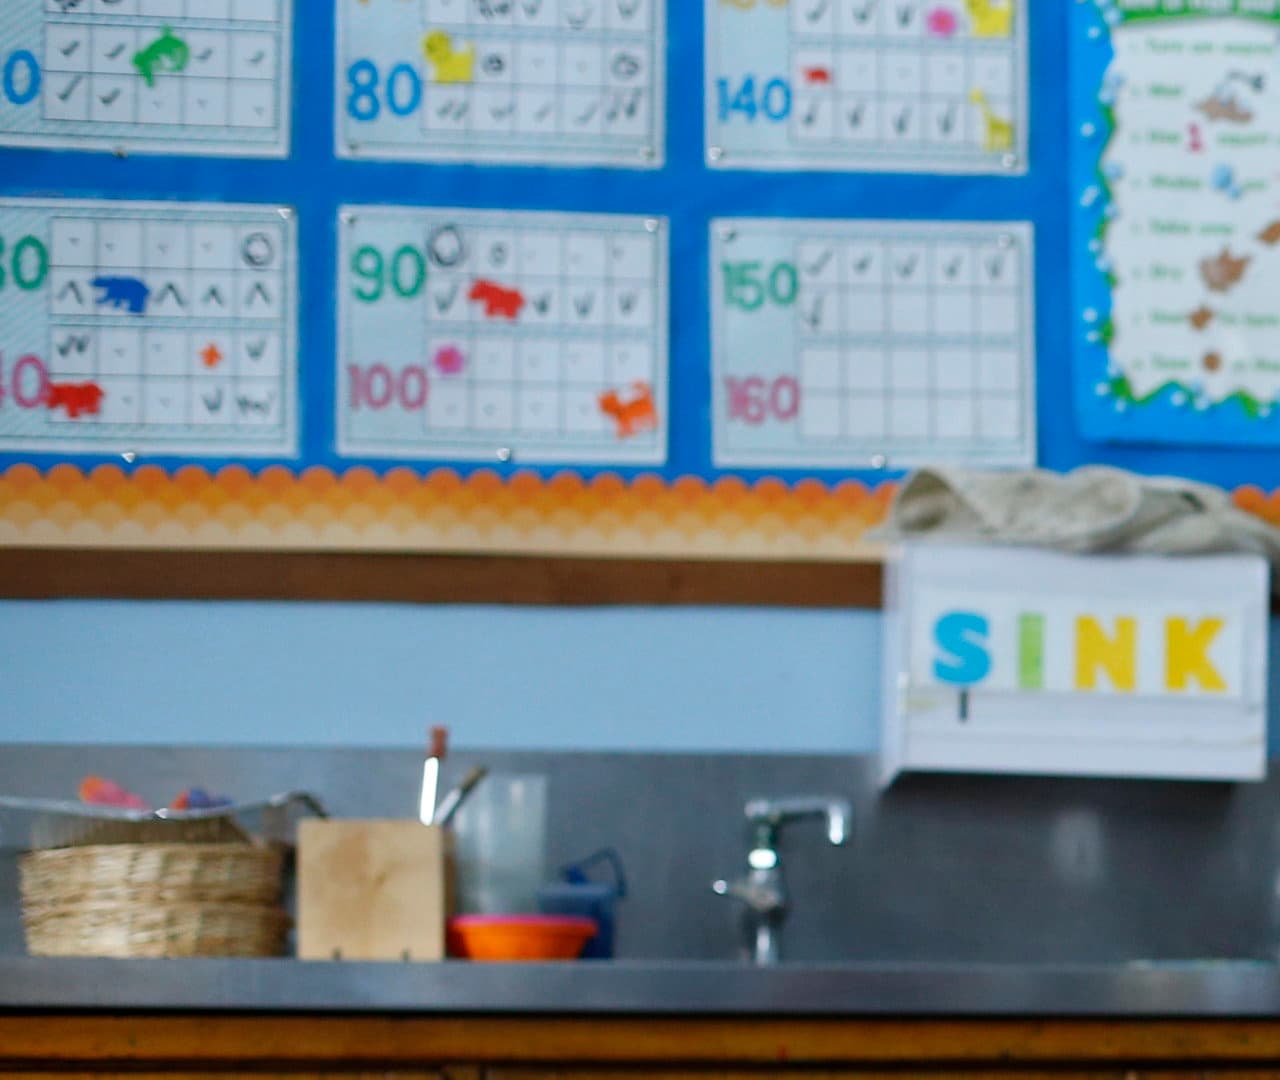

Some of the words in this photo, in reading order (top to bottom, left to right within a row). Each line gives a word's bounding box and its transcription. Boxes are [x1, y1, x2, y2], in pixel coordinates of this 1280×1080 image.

[1, 49, 42, 105] 0
[346, 59, 421, 122] 80
[717, 74, 792, 122] 140
[352, 244, 427, 302] 90
[722, 260, 798, 312] 150
[0, 356, 49, 409] 0
[350, 364, 430, 411] 100
[725, 374, 800, 426] 160
[932, 610, 1228, 692] SINK
